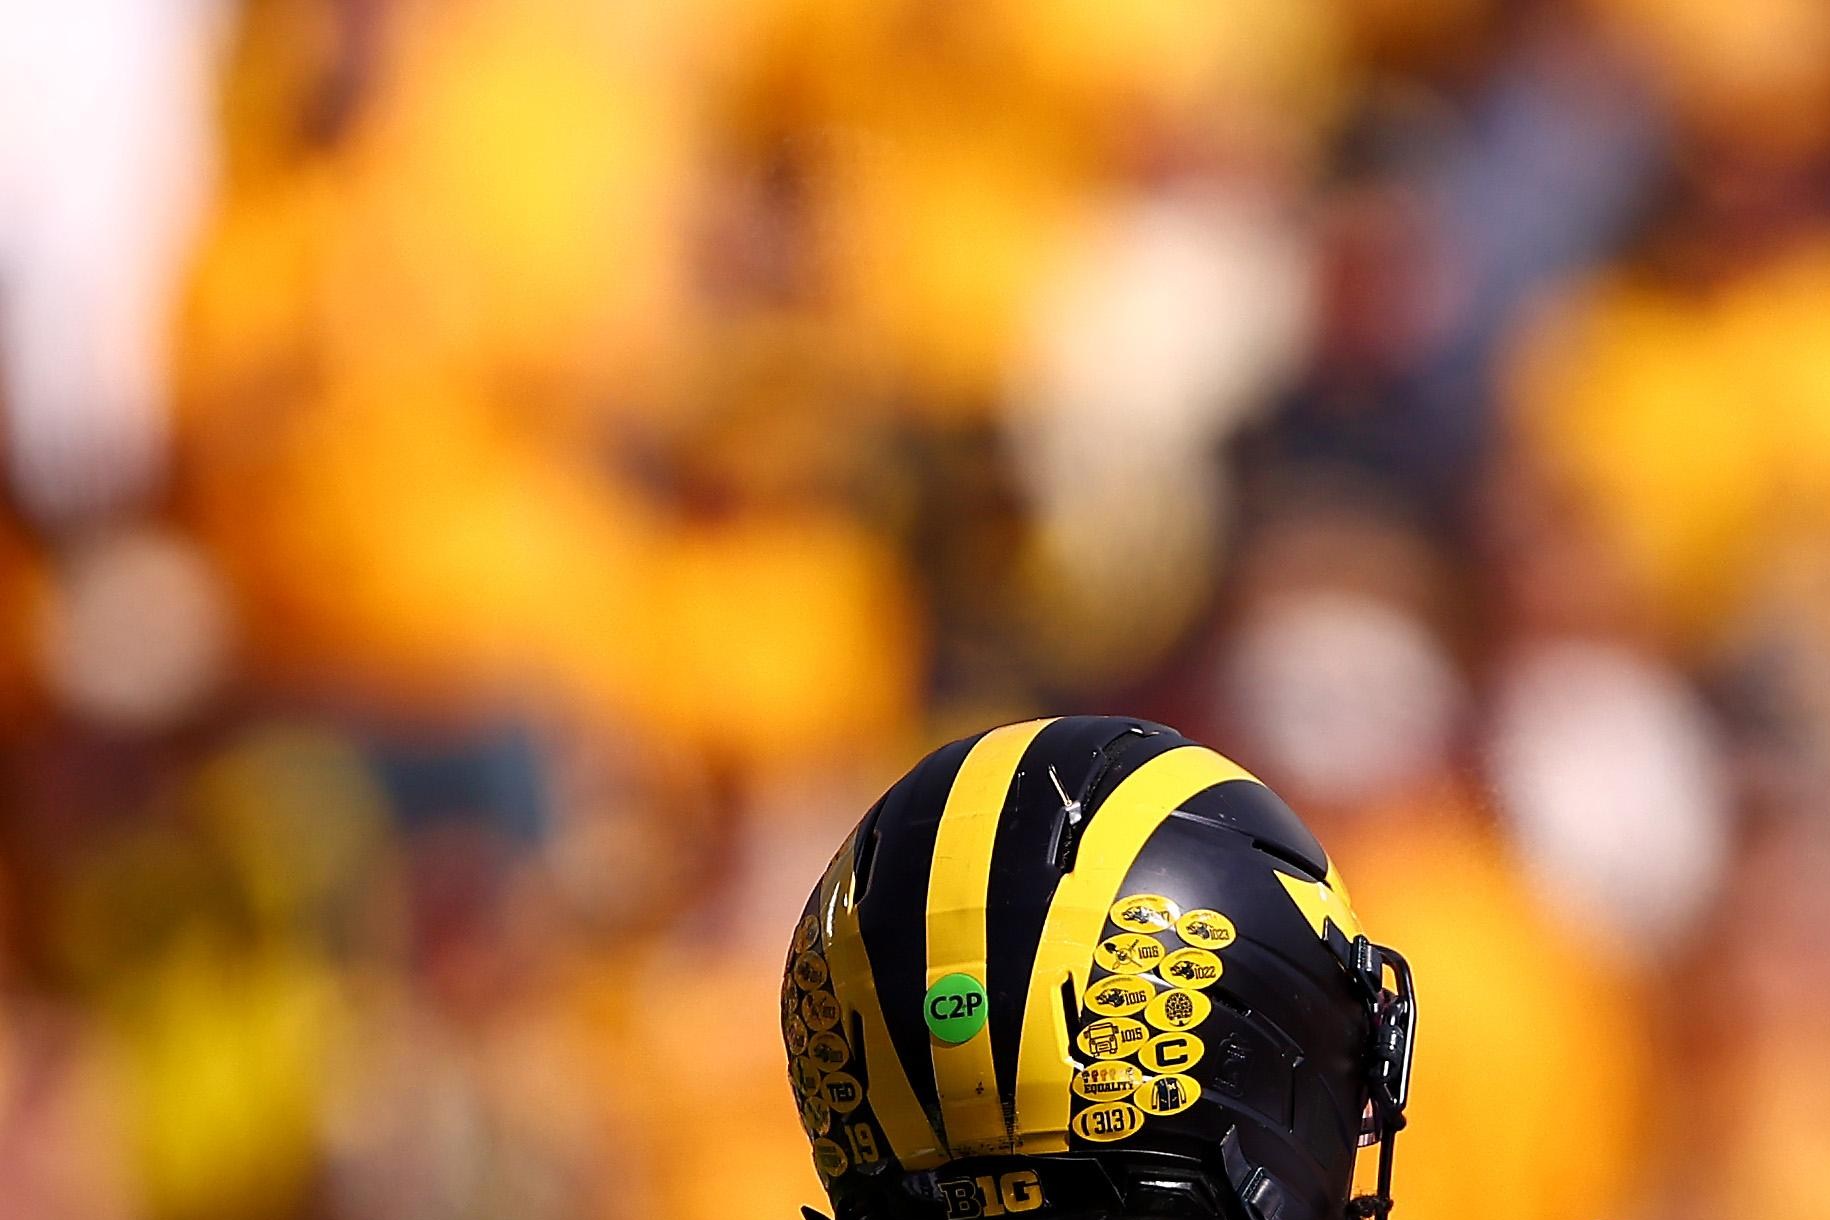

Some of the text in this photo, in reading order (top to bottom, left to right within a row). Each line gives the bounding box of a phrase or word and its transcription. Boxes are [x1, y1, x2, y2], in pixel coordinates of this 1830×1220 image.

[929, 991, 983, 1021] C2P
[1121, 1027, 1143, 1043] 1015
[1155, 1038, 1188, 1067] C
[1083, 1081, 1134, 1095] EQUALITY
[844, 1121, 879, 1165] 19
